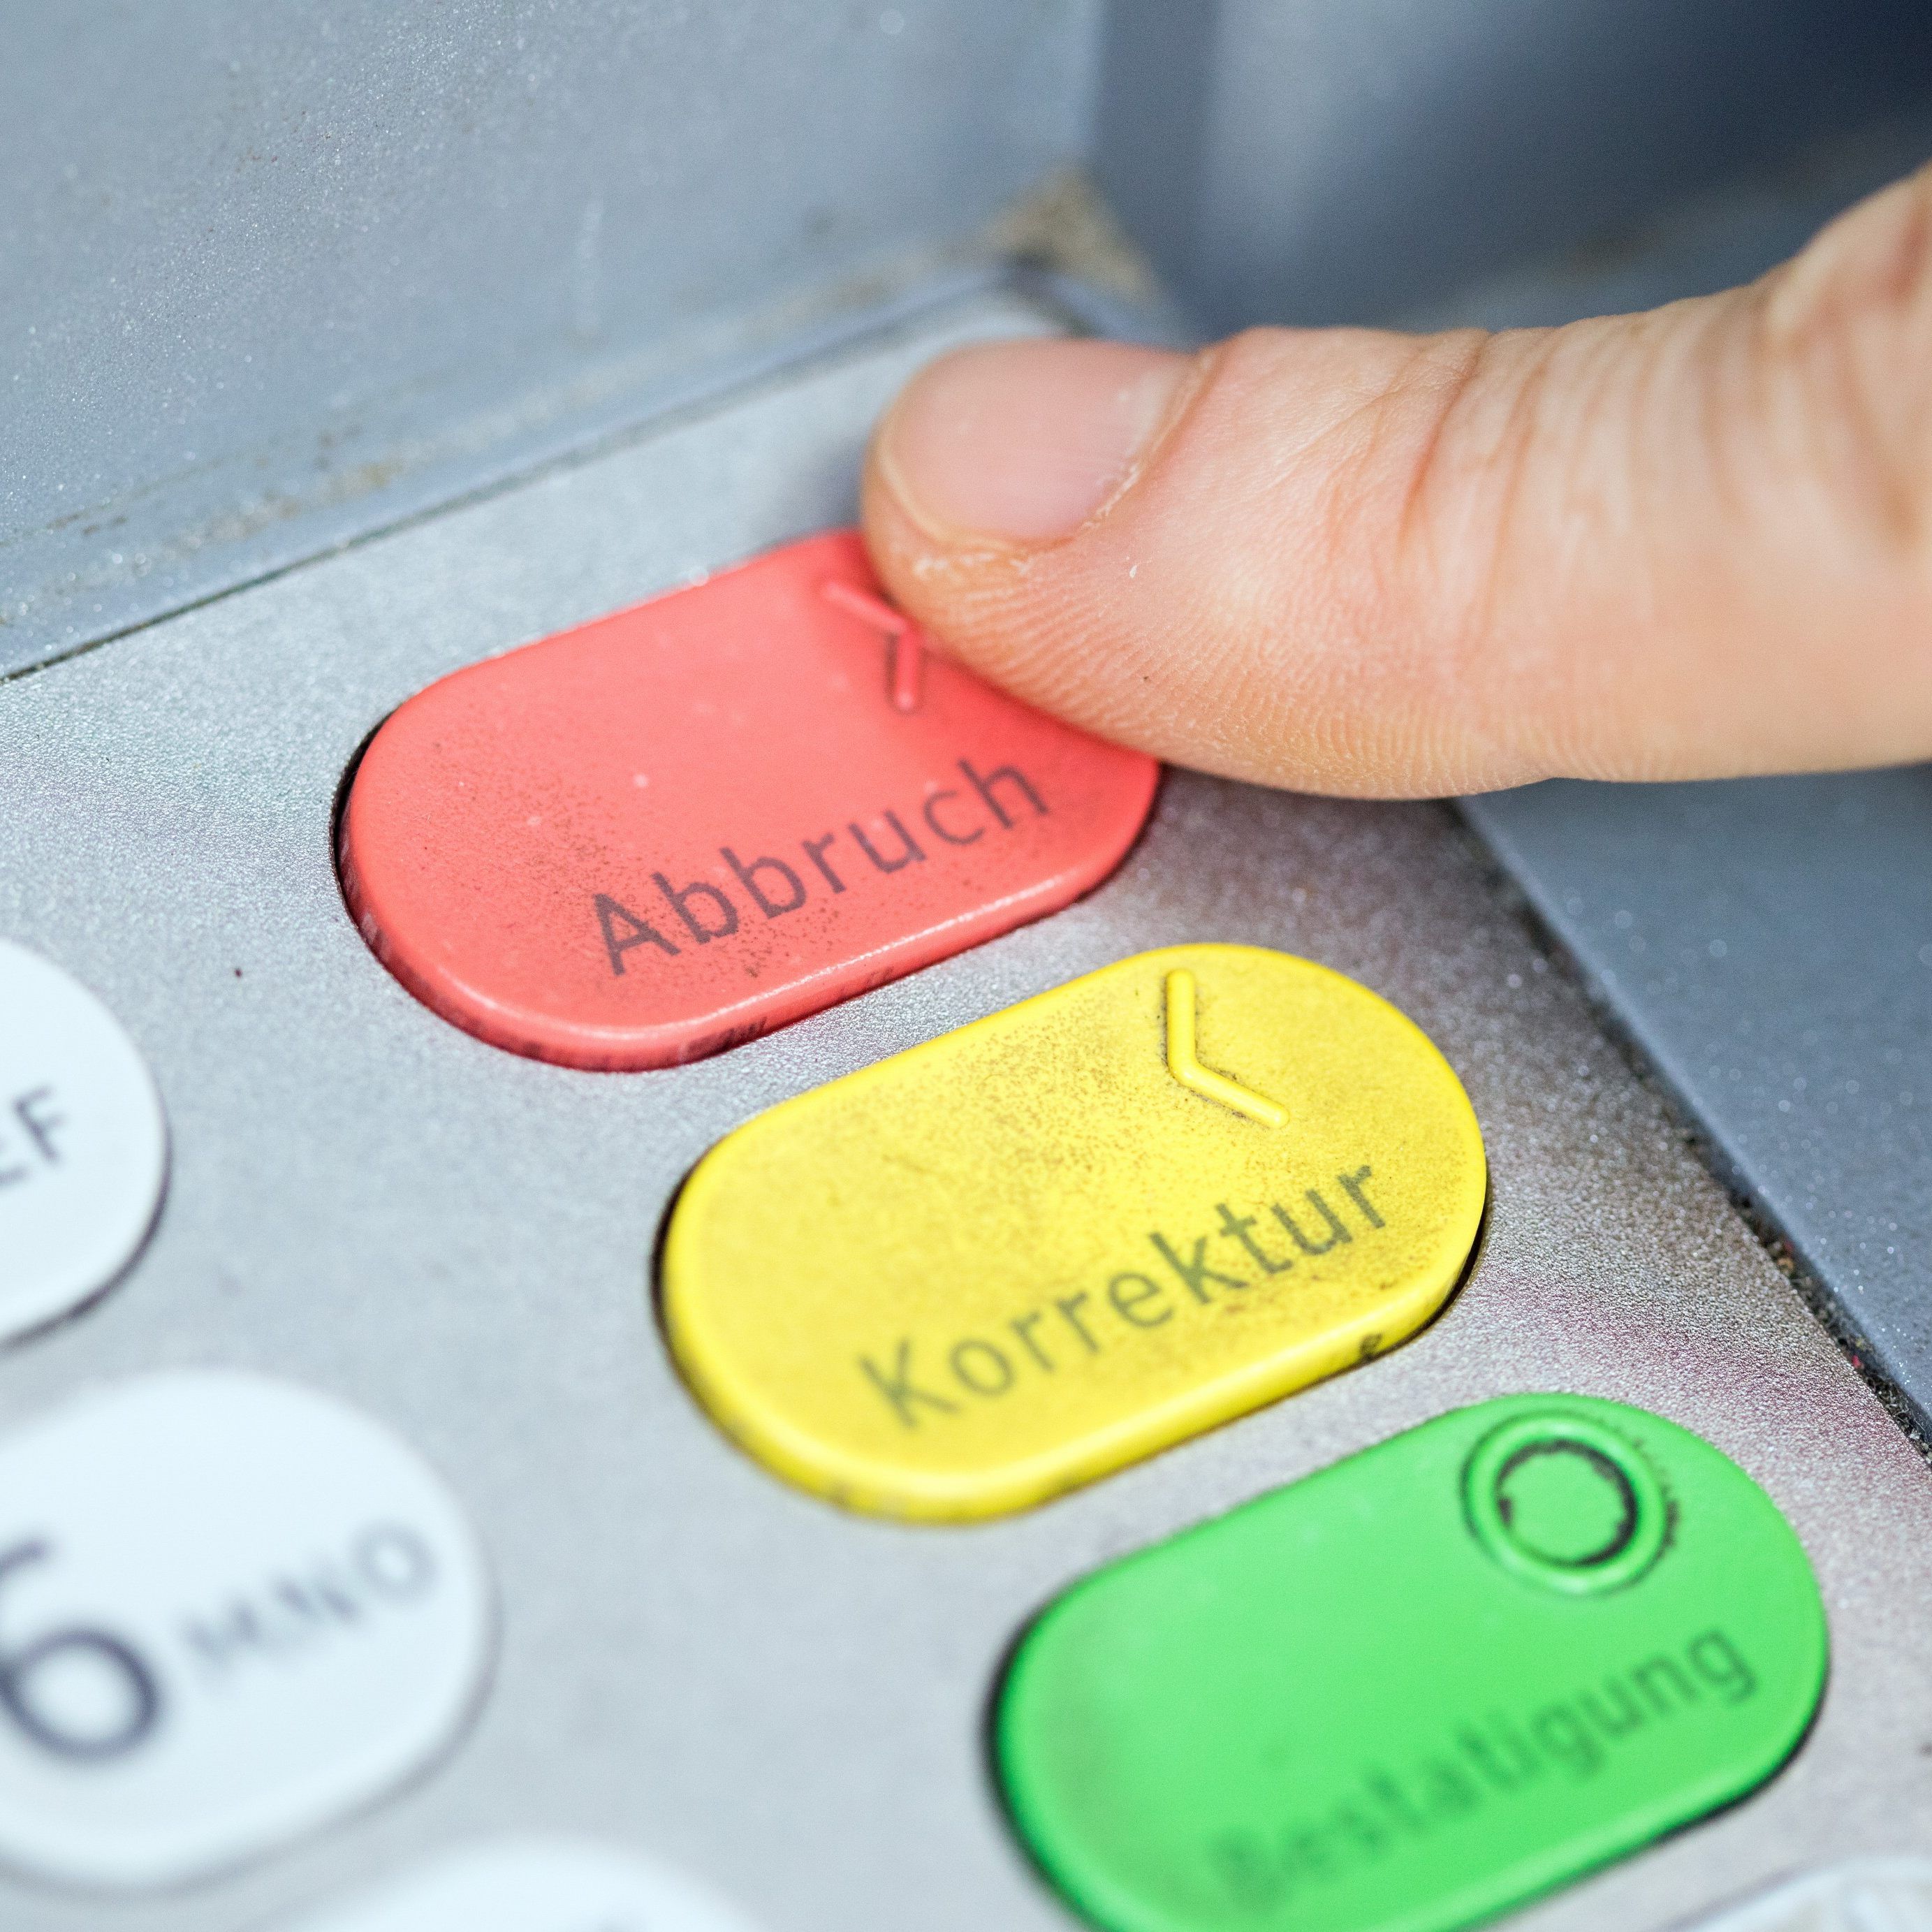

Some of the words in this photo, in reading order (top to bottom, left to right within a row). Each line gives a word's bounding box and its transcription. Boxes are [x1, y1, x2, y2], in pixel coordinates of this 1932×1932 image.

[592, 759, 1048, 977] Abbruch
[858, 1165, 1389, 1430] Korrektur
[0, 1535, 162, 1760] 6
